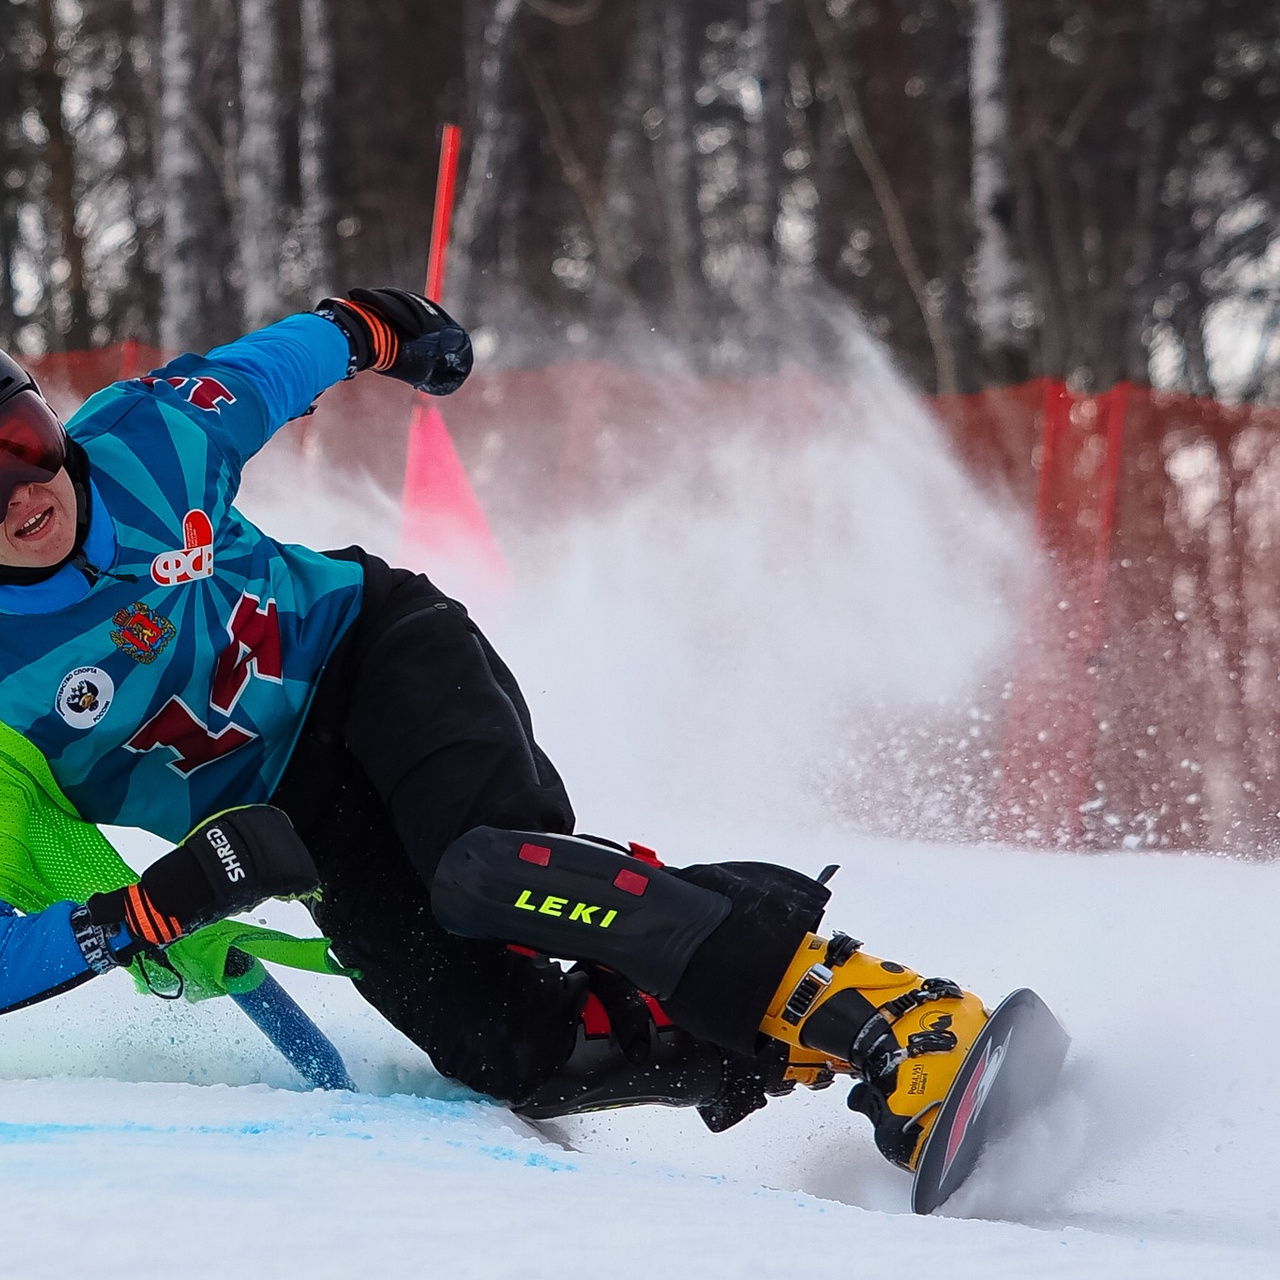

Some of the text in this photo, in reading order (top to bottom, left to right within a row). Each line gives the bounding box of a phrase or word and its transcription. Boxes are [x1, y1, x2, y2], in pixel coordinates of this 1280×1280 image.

[121, 588, 283, 780] 14
[206, 827, 246, 883] SHRED
[514, 889, 618, 928] LEKI
